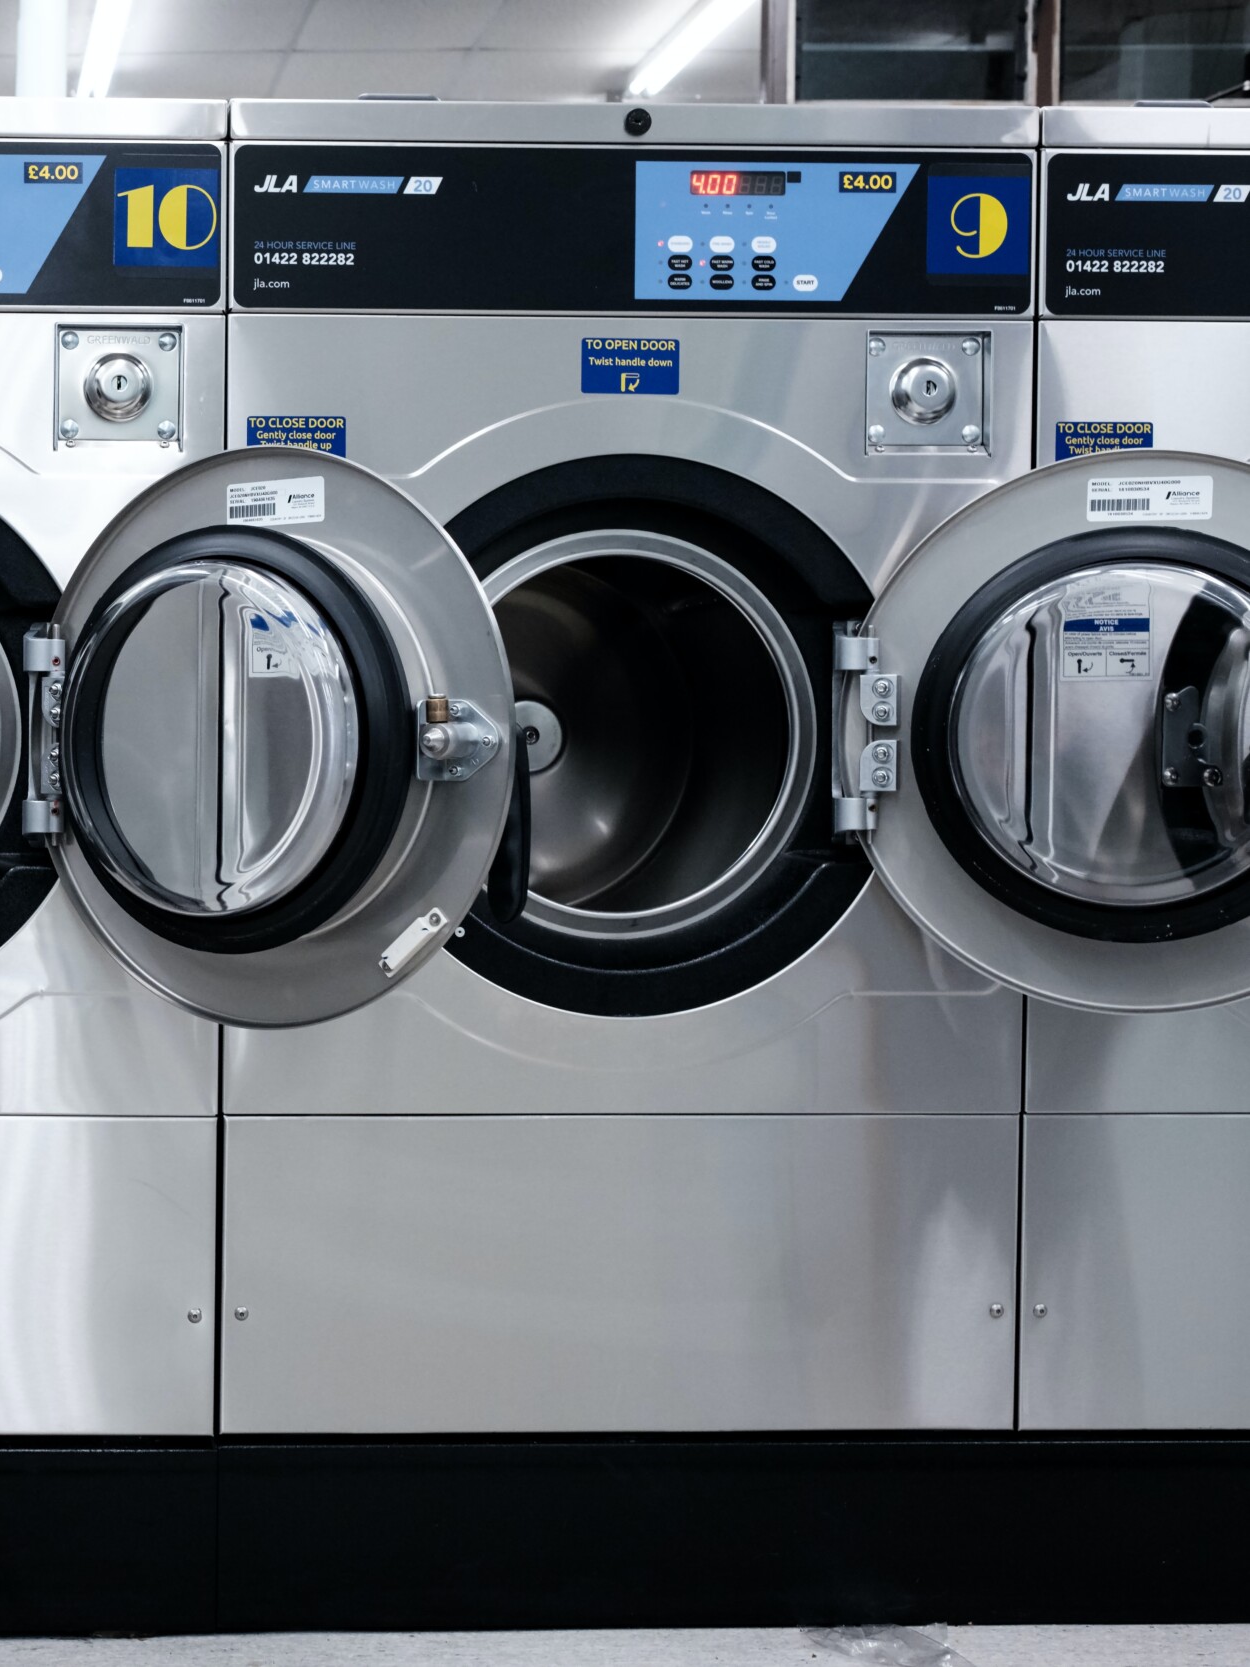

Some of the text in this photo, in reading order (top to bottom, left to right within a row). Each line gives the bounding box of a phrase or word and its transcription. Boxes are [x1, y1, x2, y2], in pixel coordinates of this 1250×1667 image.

[28, 164, 79, 181] £4.00
[253, 175, 298, 193] JLA
[413, 180, 433, 193] 20
[692, 174, 737, 194] 4.00
[842, 175, 893, 190] £4.00
[1066, 183, 1110, 201] JLA
[1223, 187, 1242, 200] 20
[116, 184, 217, 250] 10
[950, 192, 1008, 259] 9
[254, 240, 357, 250] 24 HOUR SERVICE LINE
[254, 252, 355, 266] 01422 822282
[1066, 248, 1167, 258] 24 HOUR SERVICE LINE
[1066, 260, 1165, 273] 01422 822282
[253, 278, 290, 291] jla.com
[1065, 286, 1101, 298] jla.com
[585, 339, 676, 351] TO OPEN DOOR
[588, 357, 673, 367] Twist handle down
[248, 417, 344, 429] TO CLOSE DOOR
[1058, 423, 1151, 434] TO CLOSE DOOR
[256, 430, 336, 440] Gently close door
[1065, 436, 1143, 446] Gently close door
[320, 442, 332, 451] up
[1069, 445, 1122, 455] Twist handl
